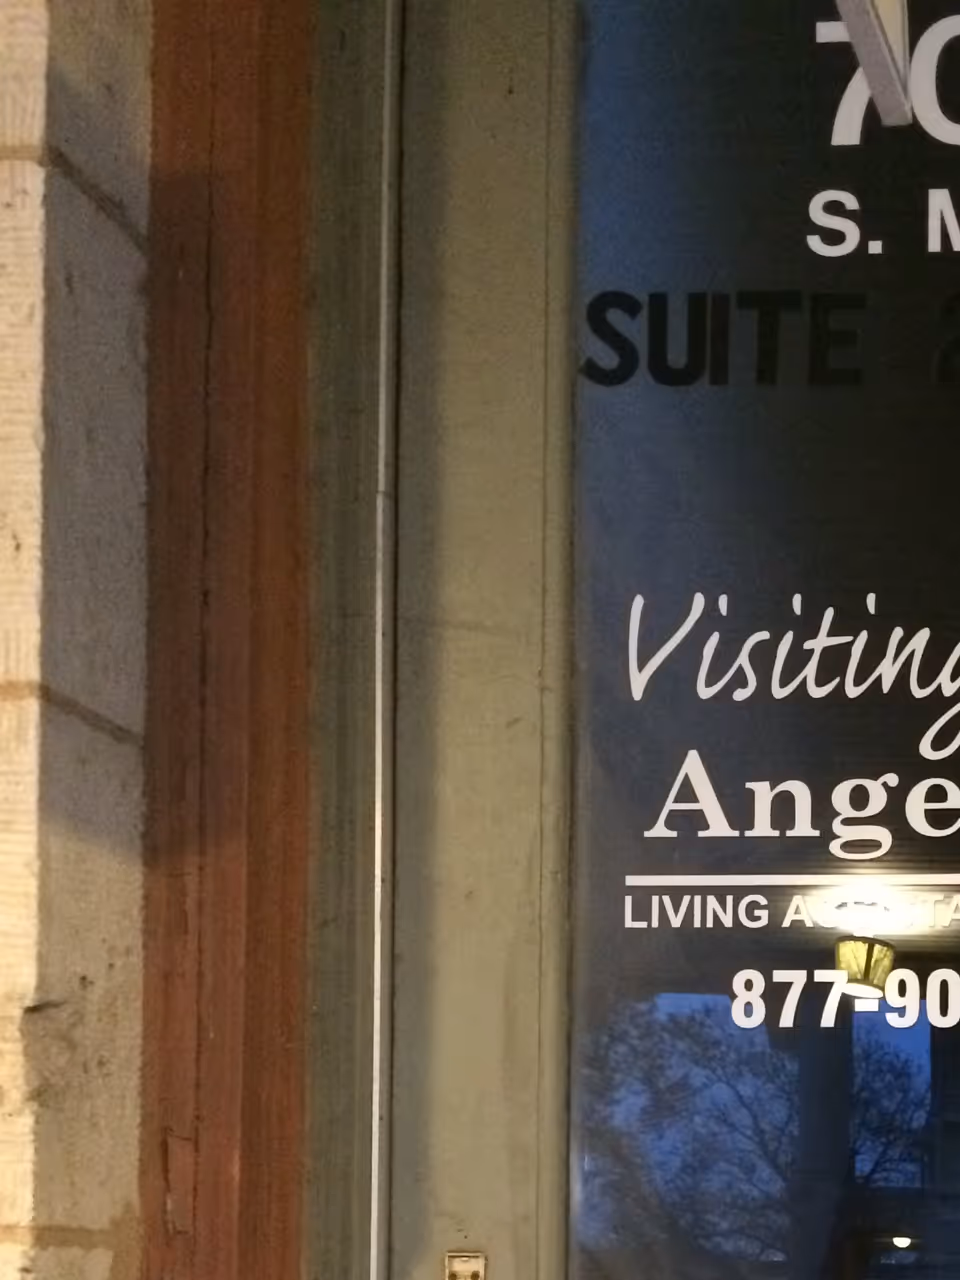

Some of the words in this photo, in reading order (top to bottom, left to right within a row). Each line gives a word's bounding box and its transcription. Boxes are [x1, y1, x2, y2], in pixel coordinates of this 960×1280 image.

[806, 190, 883, 257] S.
[577, 290, 866, 388] SUITE
[623, 894, 769, 928] LIVING
